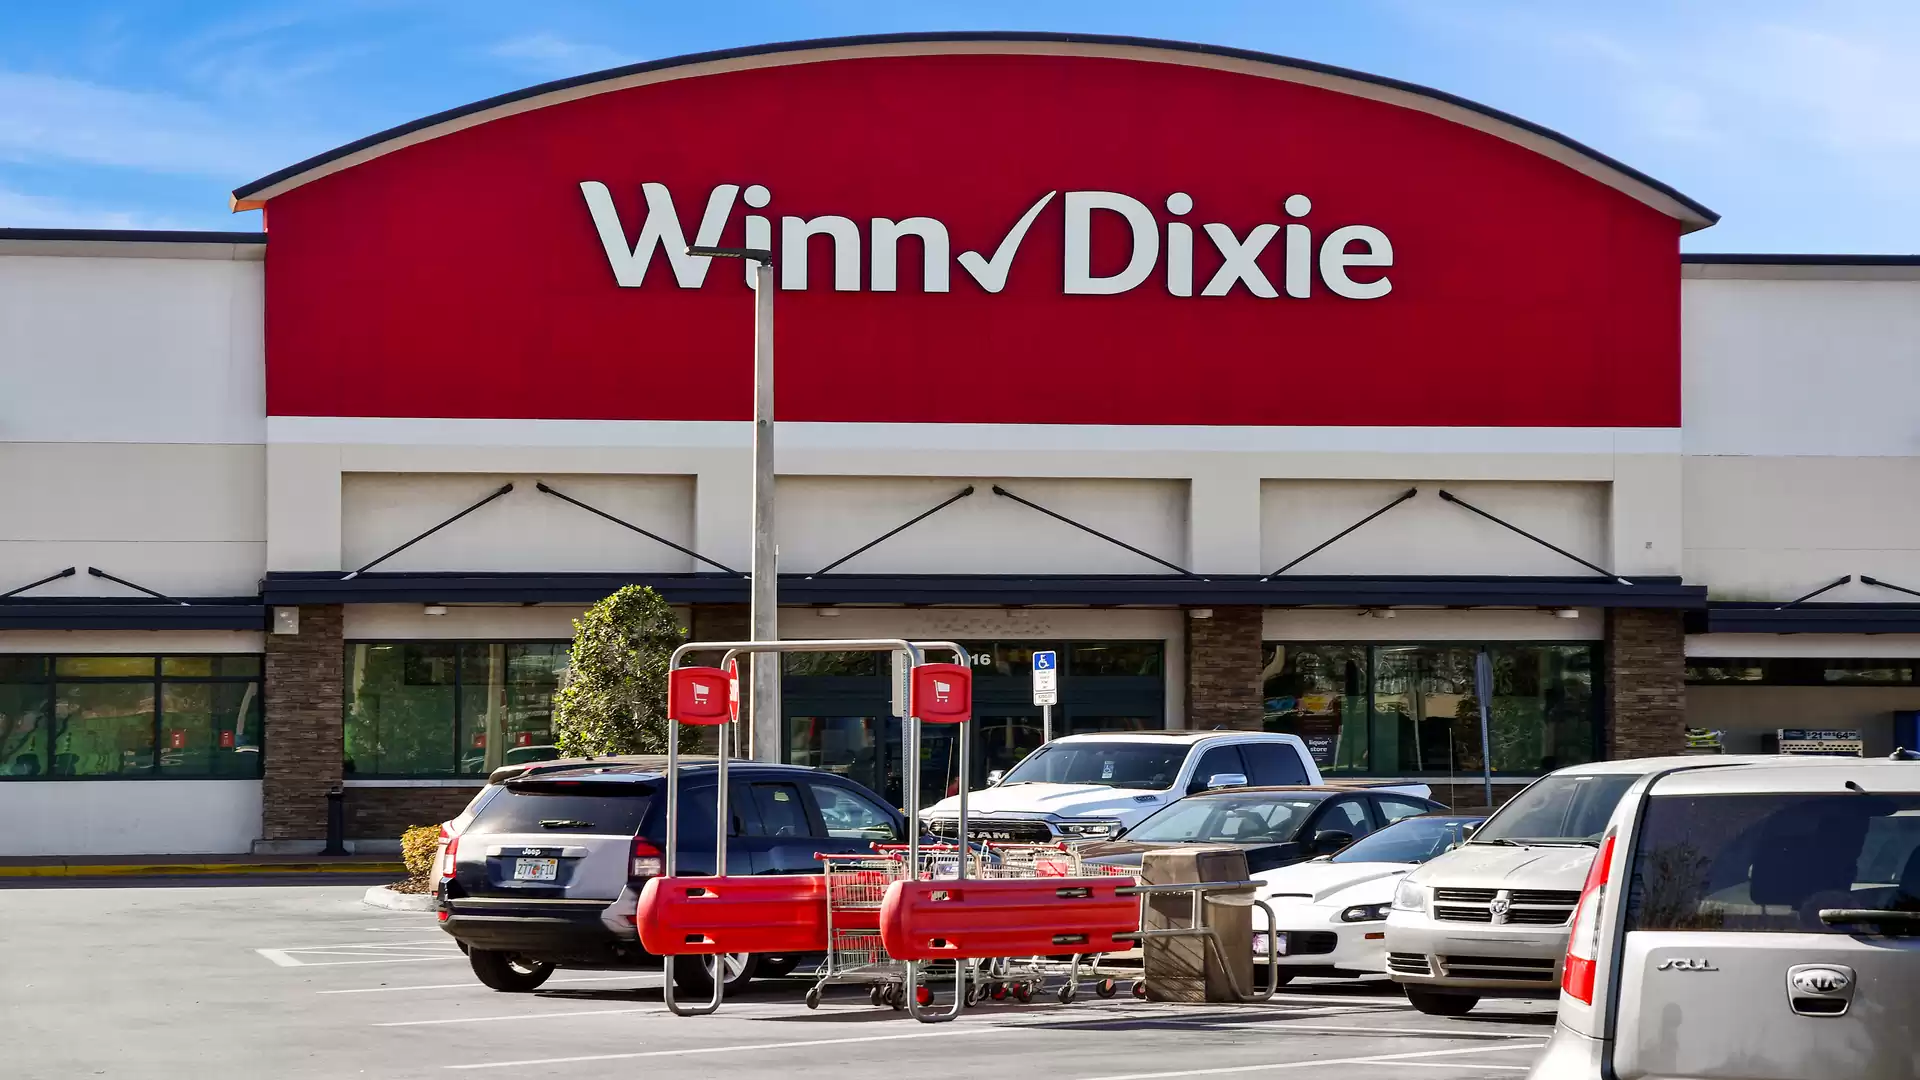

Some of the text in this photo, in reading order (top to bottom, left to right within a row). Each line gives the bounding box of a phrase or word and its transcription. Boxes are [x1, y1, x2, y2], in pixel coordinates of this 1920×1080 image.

[579, 181, 1394, 299] Winn Dixie
[952, 653, 991, 666] 116
[967, 831, 1011, 839] RAM
[522, 847, 541, 856] Jeep
[1656, 957, 1720, 971] SOUL
[1801, 975, 1838, 988] KIA
